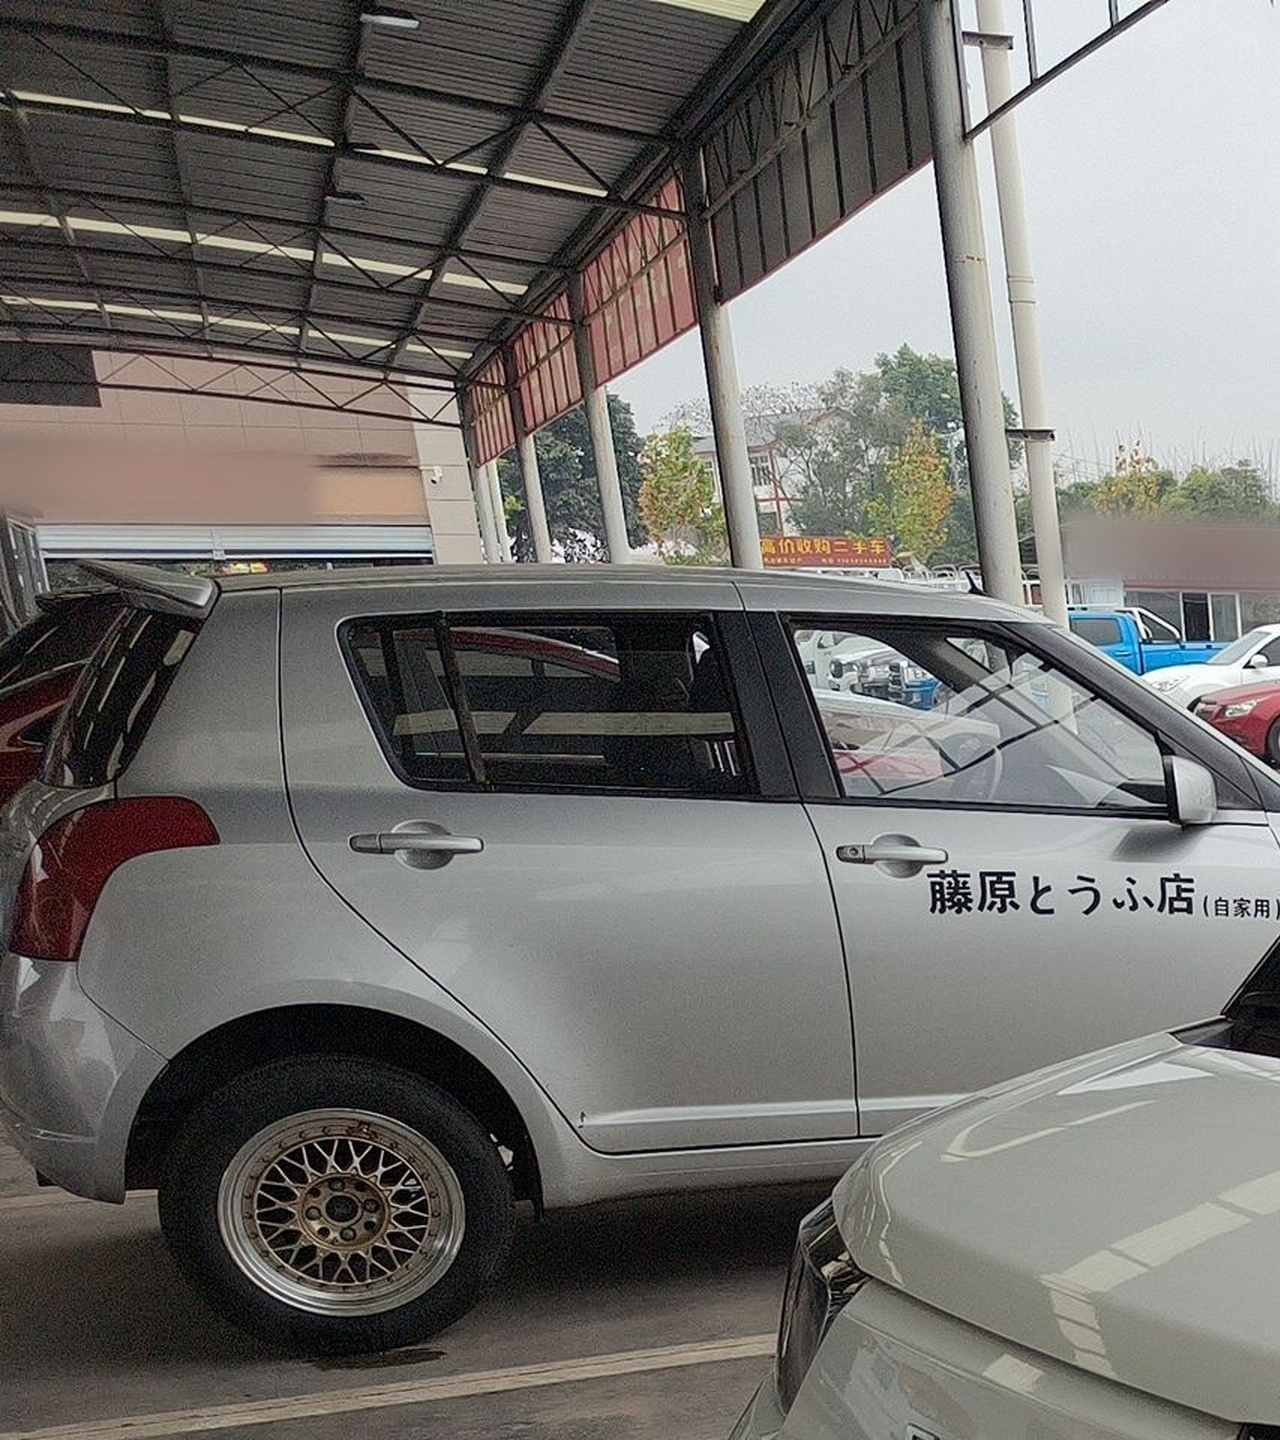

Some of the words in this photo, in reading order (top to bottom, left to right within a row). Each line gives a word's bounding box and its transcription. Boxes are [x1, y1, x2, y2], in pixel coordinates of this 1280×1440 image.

[761, 538, 886, 554] 高价收购二手车
[926, 870, 1195, 915] 藤原とうふ店
